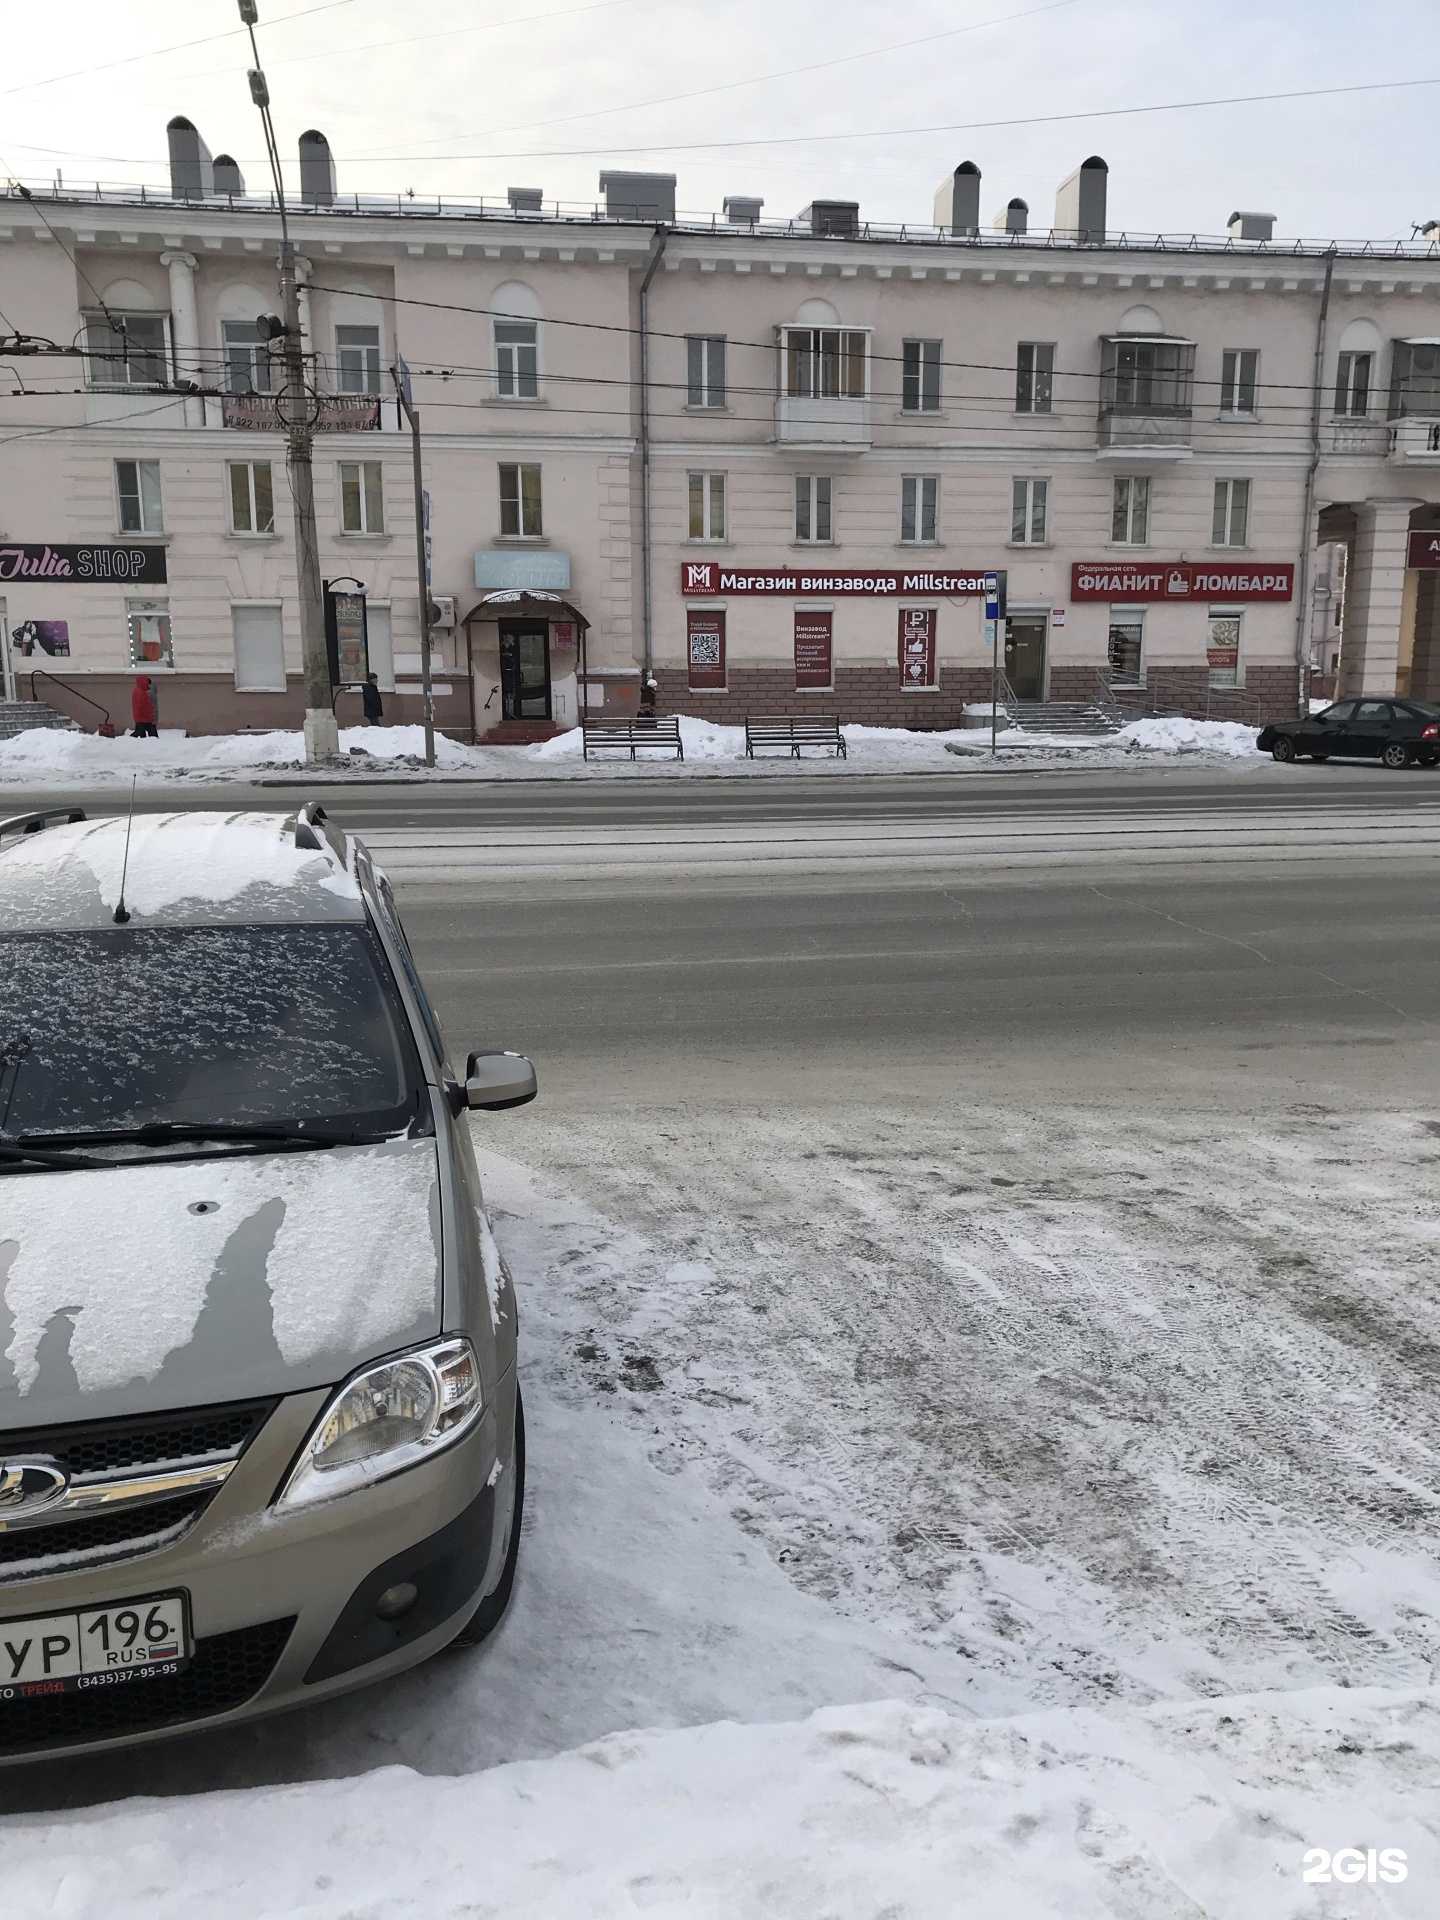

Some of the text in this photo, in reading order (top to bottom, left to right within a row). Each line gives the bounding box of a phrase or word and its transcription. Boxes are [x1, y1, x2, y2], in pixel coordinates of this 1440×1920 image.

[0, 546, 146, 579] Julia SHOP
[720, 574, 796, 590] Магазин
[801, 576, 896, 592] винзавода
[1078, 575, 1289, 591] ФИАНИТ ЛОМБАРД
[87, 1606, 169, 1650] 196
[106, 1648, 147, 1665] RUS
[17, 1681, 65, 1697] ТРЕЙД
[77, 1663, 178, 1689] (3435)37-95-95
